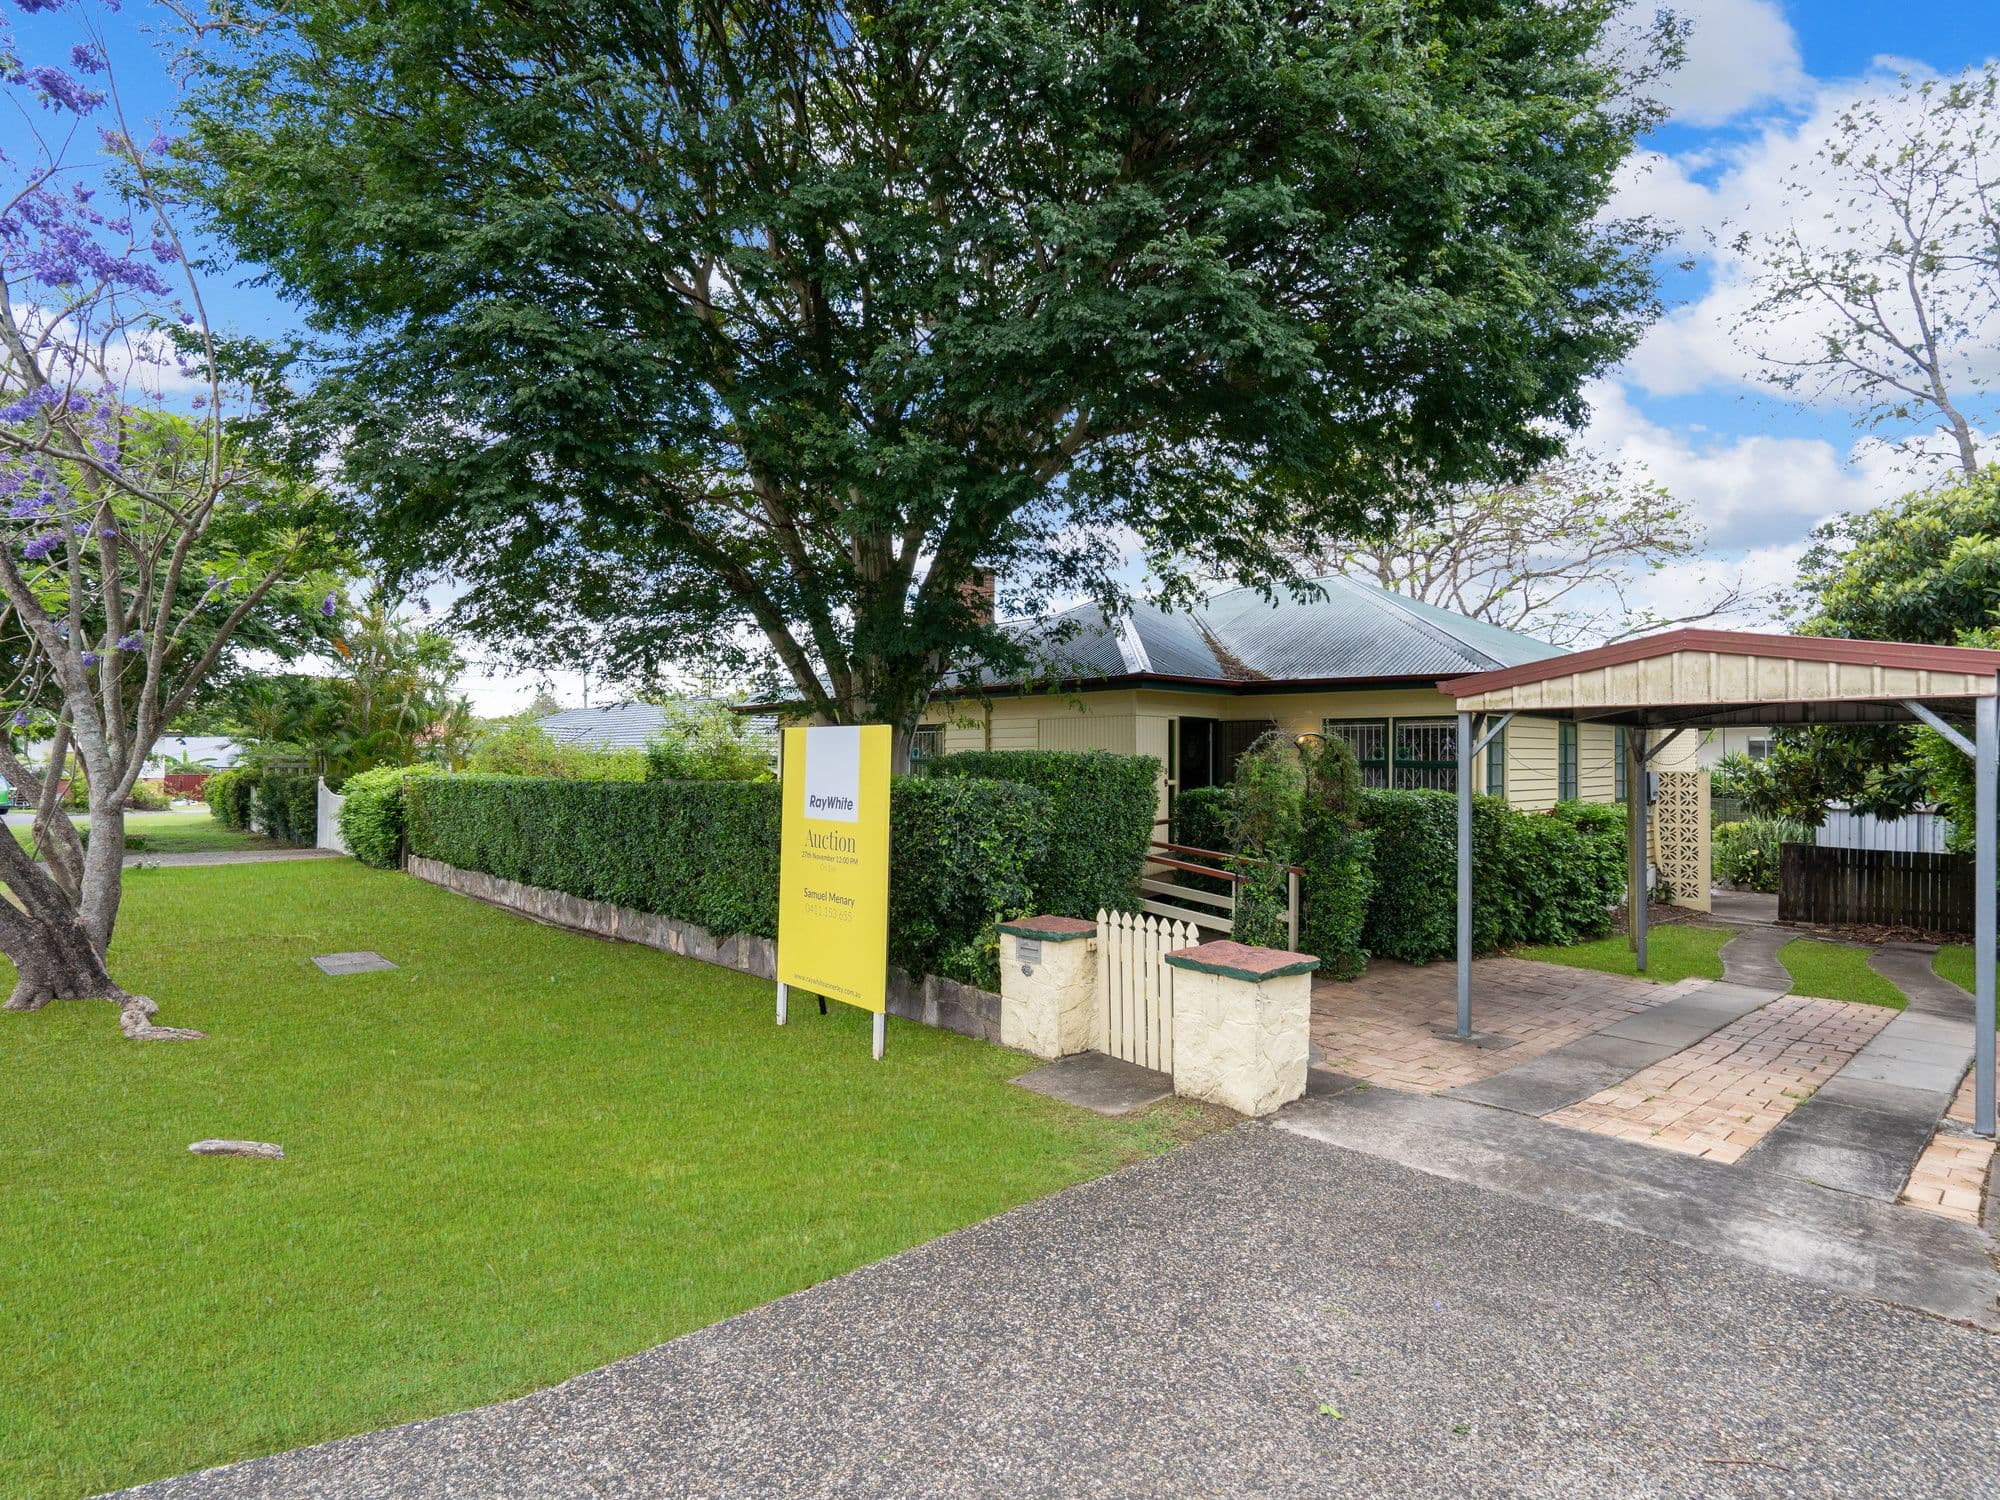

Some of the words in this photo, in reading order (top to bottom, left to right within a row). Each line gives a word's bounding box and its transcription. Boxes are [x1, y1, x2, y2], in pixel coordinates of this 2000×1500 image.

[809, 794, 854, 811] RayWhite
[805, 829, 856, 853] Auction
[812, 852, 835, 863] November
[850, 857, 859, 866] PM
[803, 887, 828, 901] Samuel
[829, 892, 856, 909] Menary
